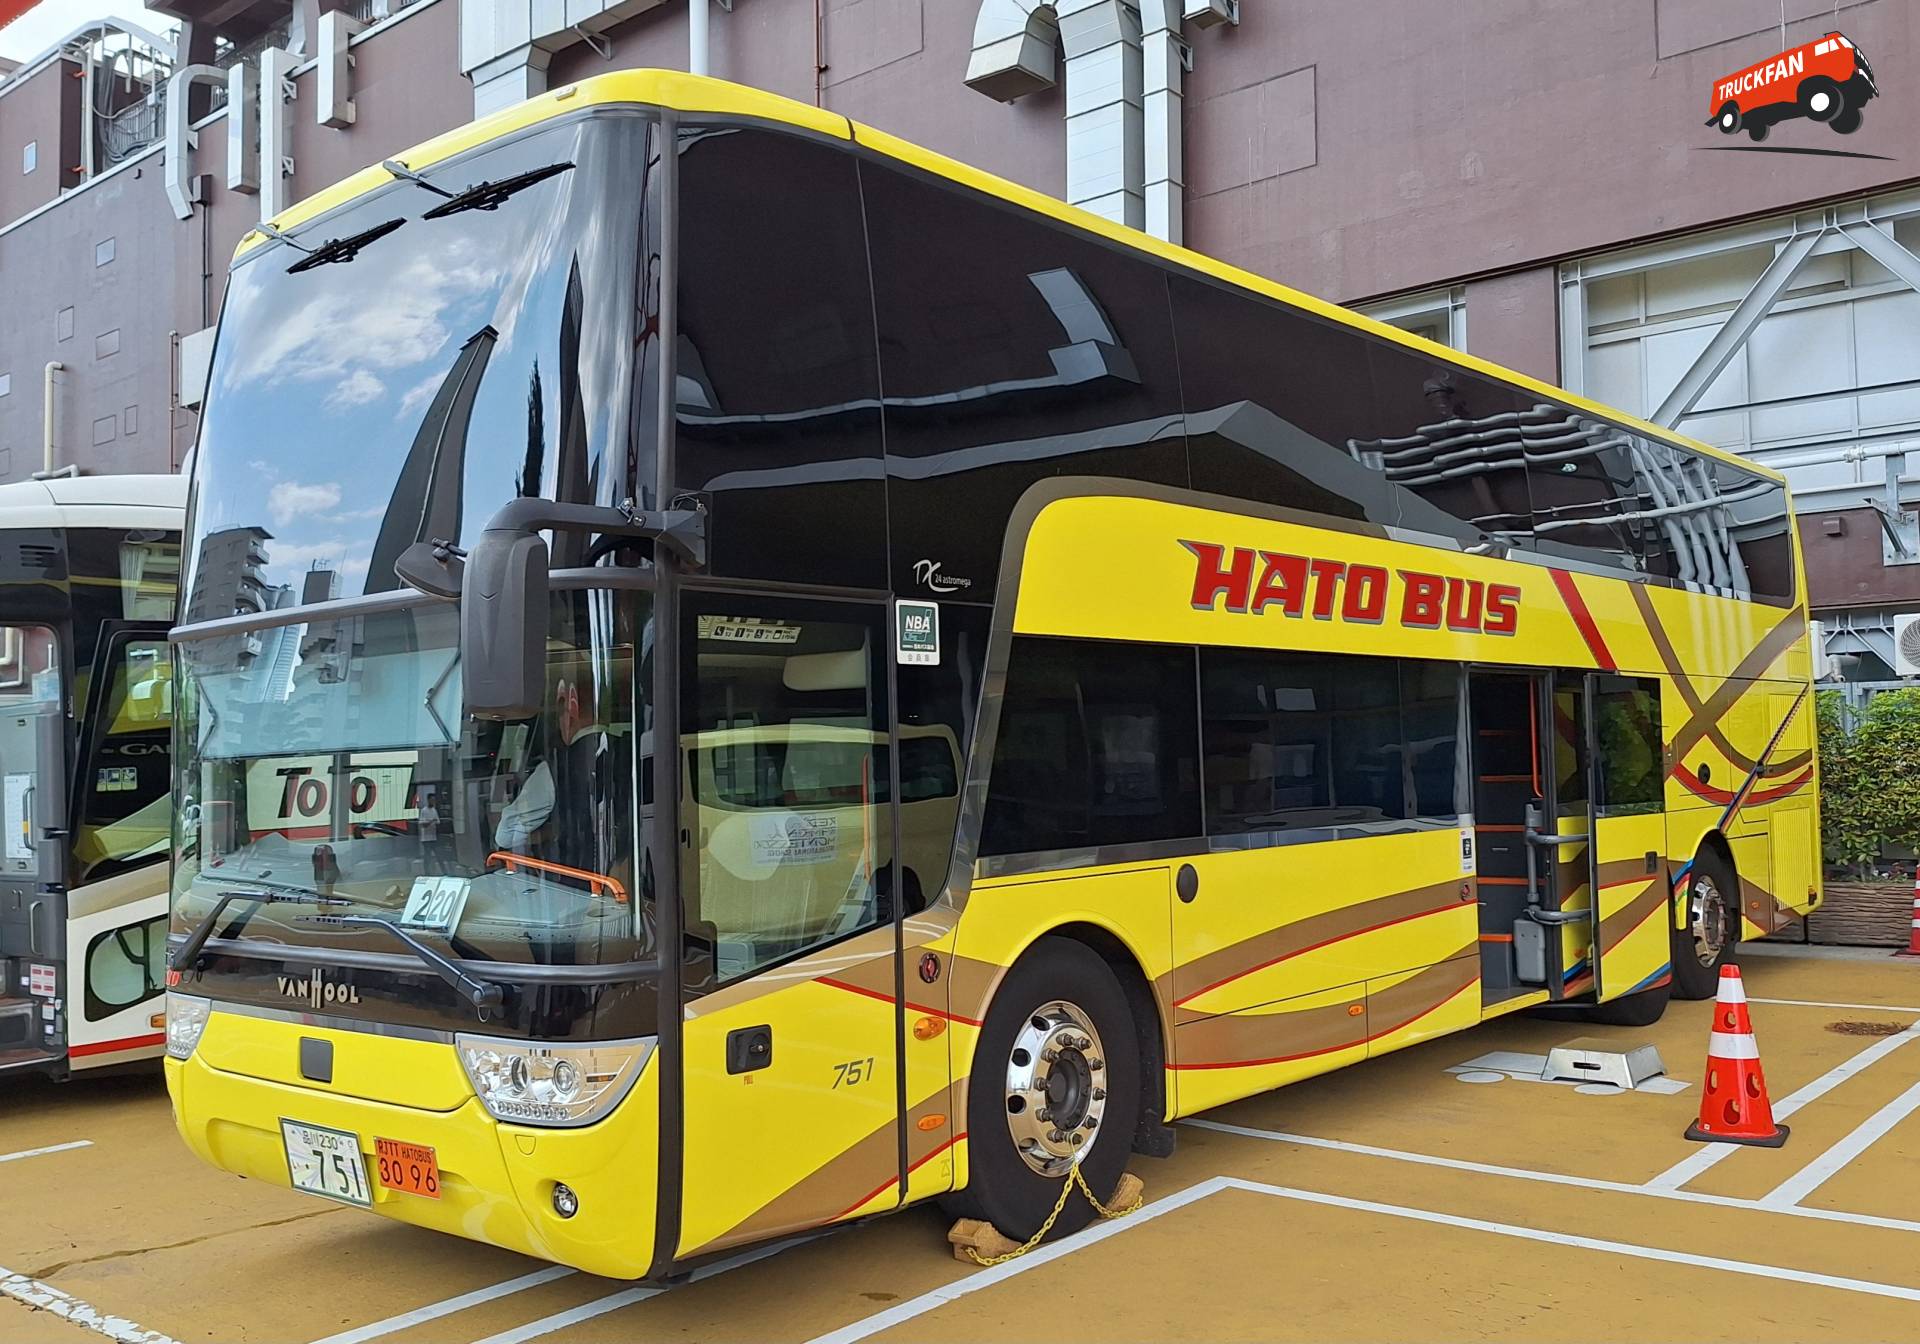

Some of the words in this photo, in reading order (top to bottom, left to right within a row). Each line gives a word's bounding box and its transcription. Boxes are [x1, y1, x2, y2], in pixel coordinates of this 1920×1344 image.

[943, 575, 972, 588] astromega
[1177, 539, 1388, 625] HATO
[1396, 568, 1521, 637] BUS
[905, 615, 931, 631] NBA
[831, 1057, 874, 1090] 751
[319, 1134, 338, 1151] 230
